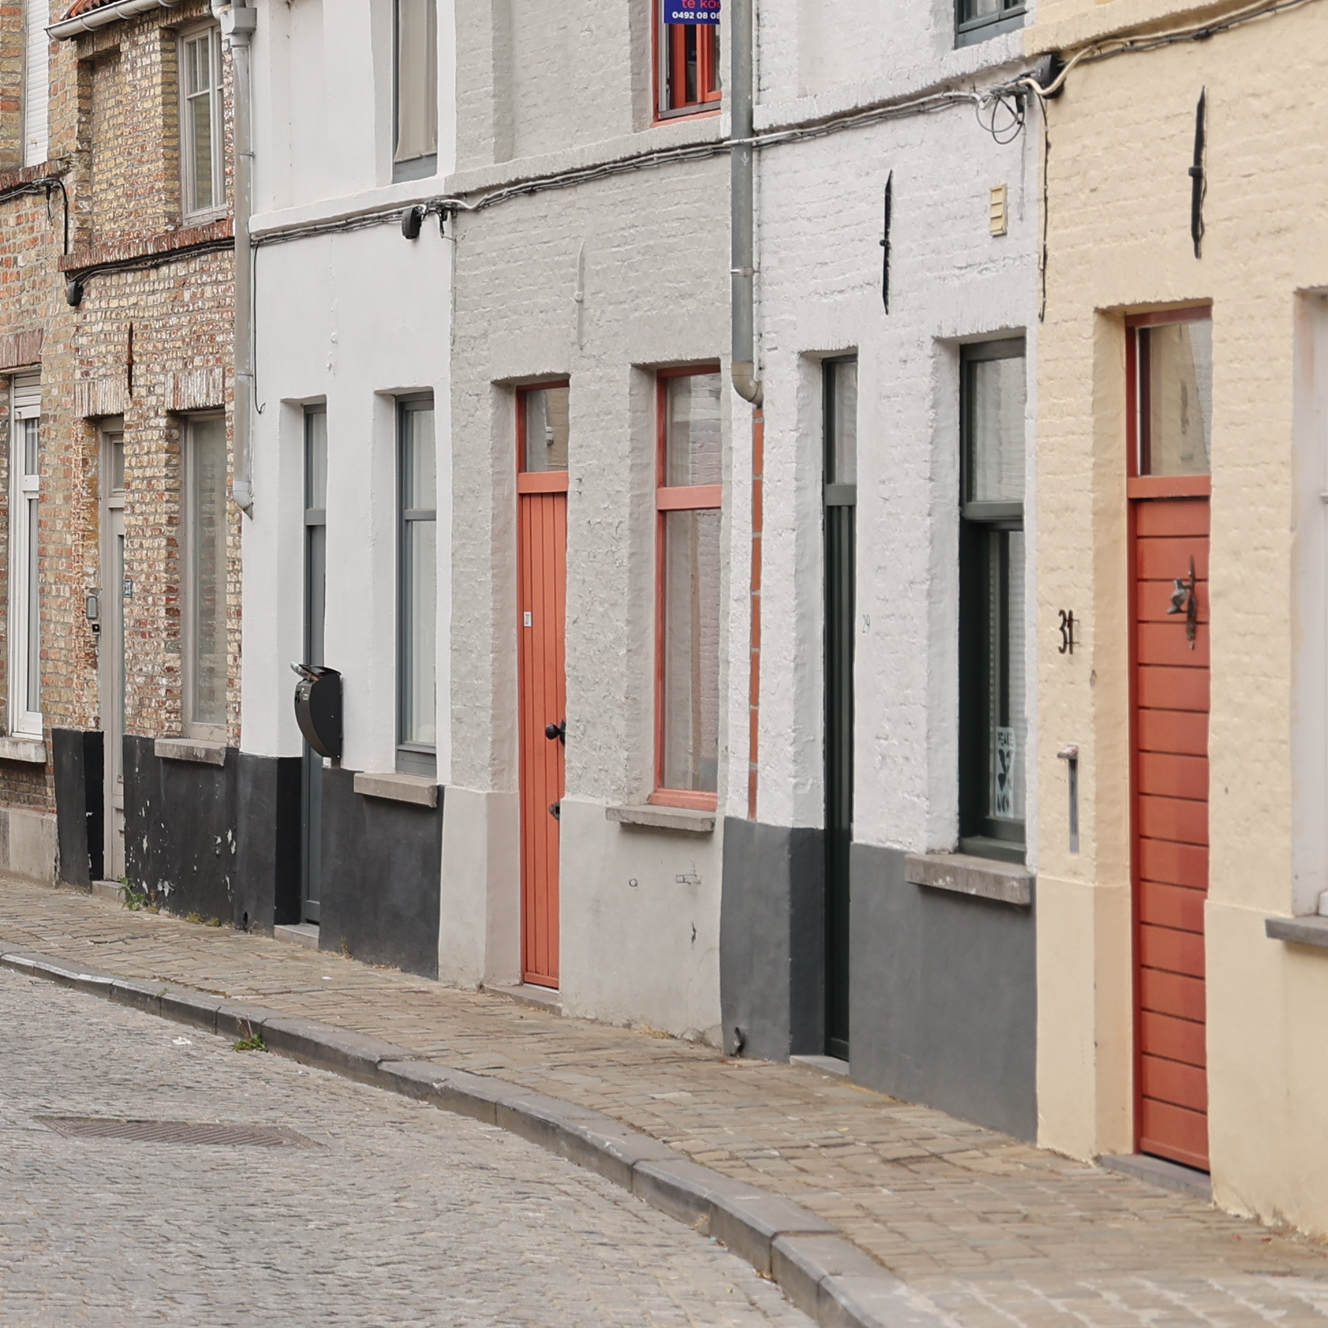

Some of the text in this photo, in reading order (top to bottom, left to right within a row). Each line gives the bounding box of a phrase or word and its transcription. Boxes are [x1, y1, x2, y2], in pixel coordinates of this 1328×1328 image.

[672, 11, 695, 20] 0492
[696, 11, 708, 20] 08
[1058, 608, 1074, 655] 31
